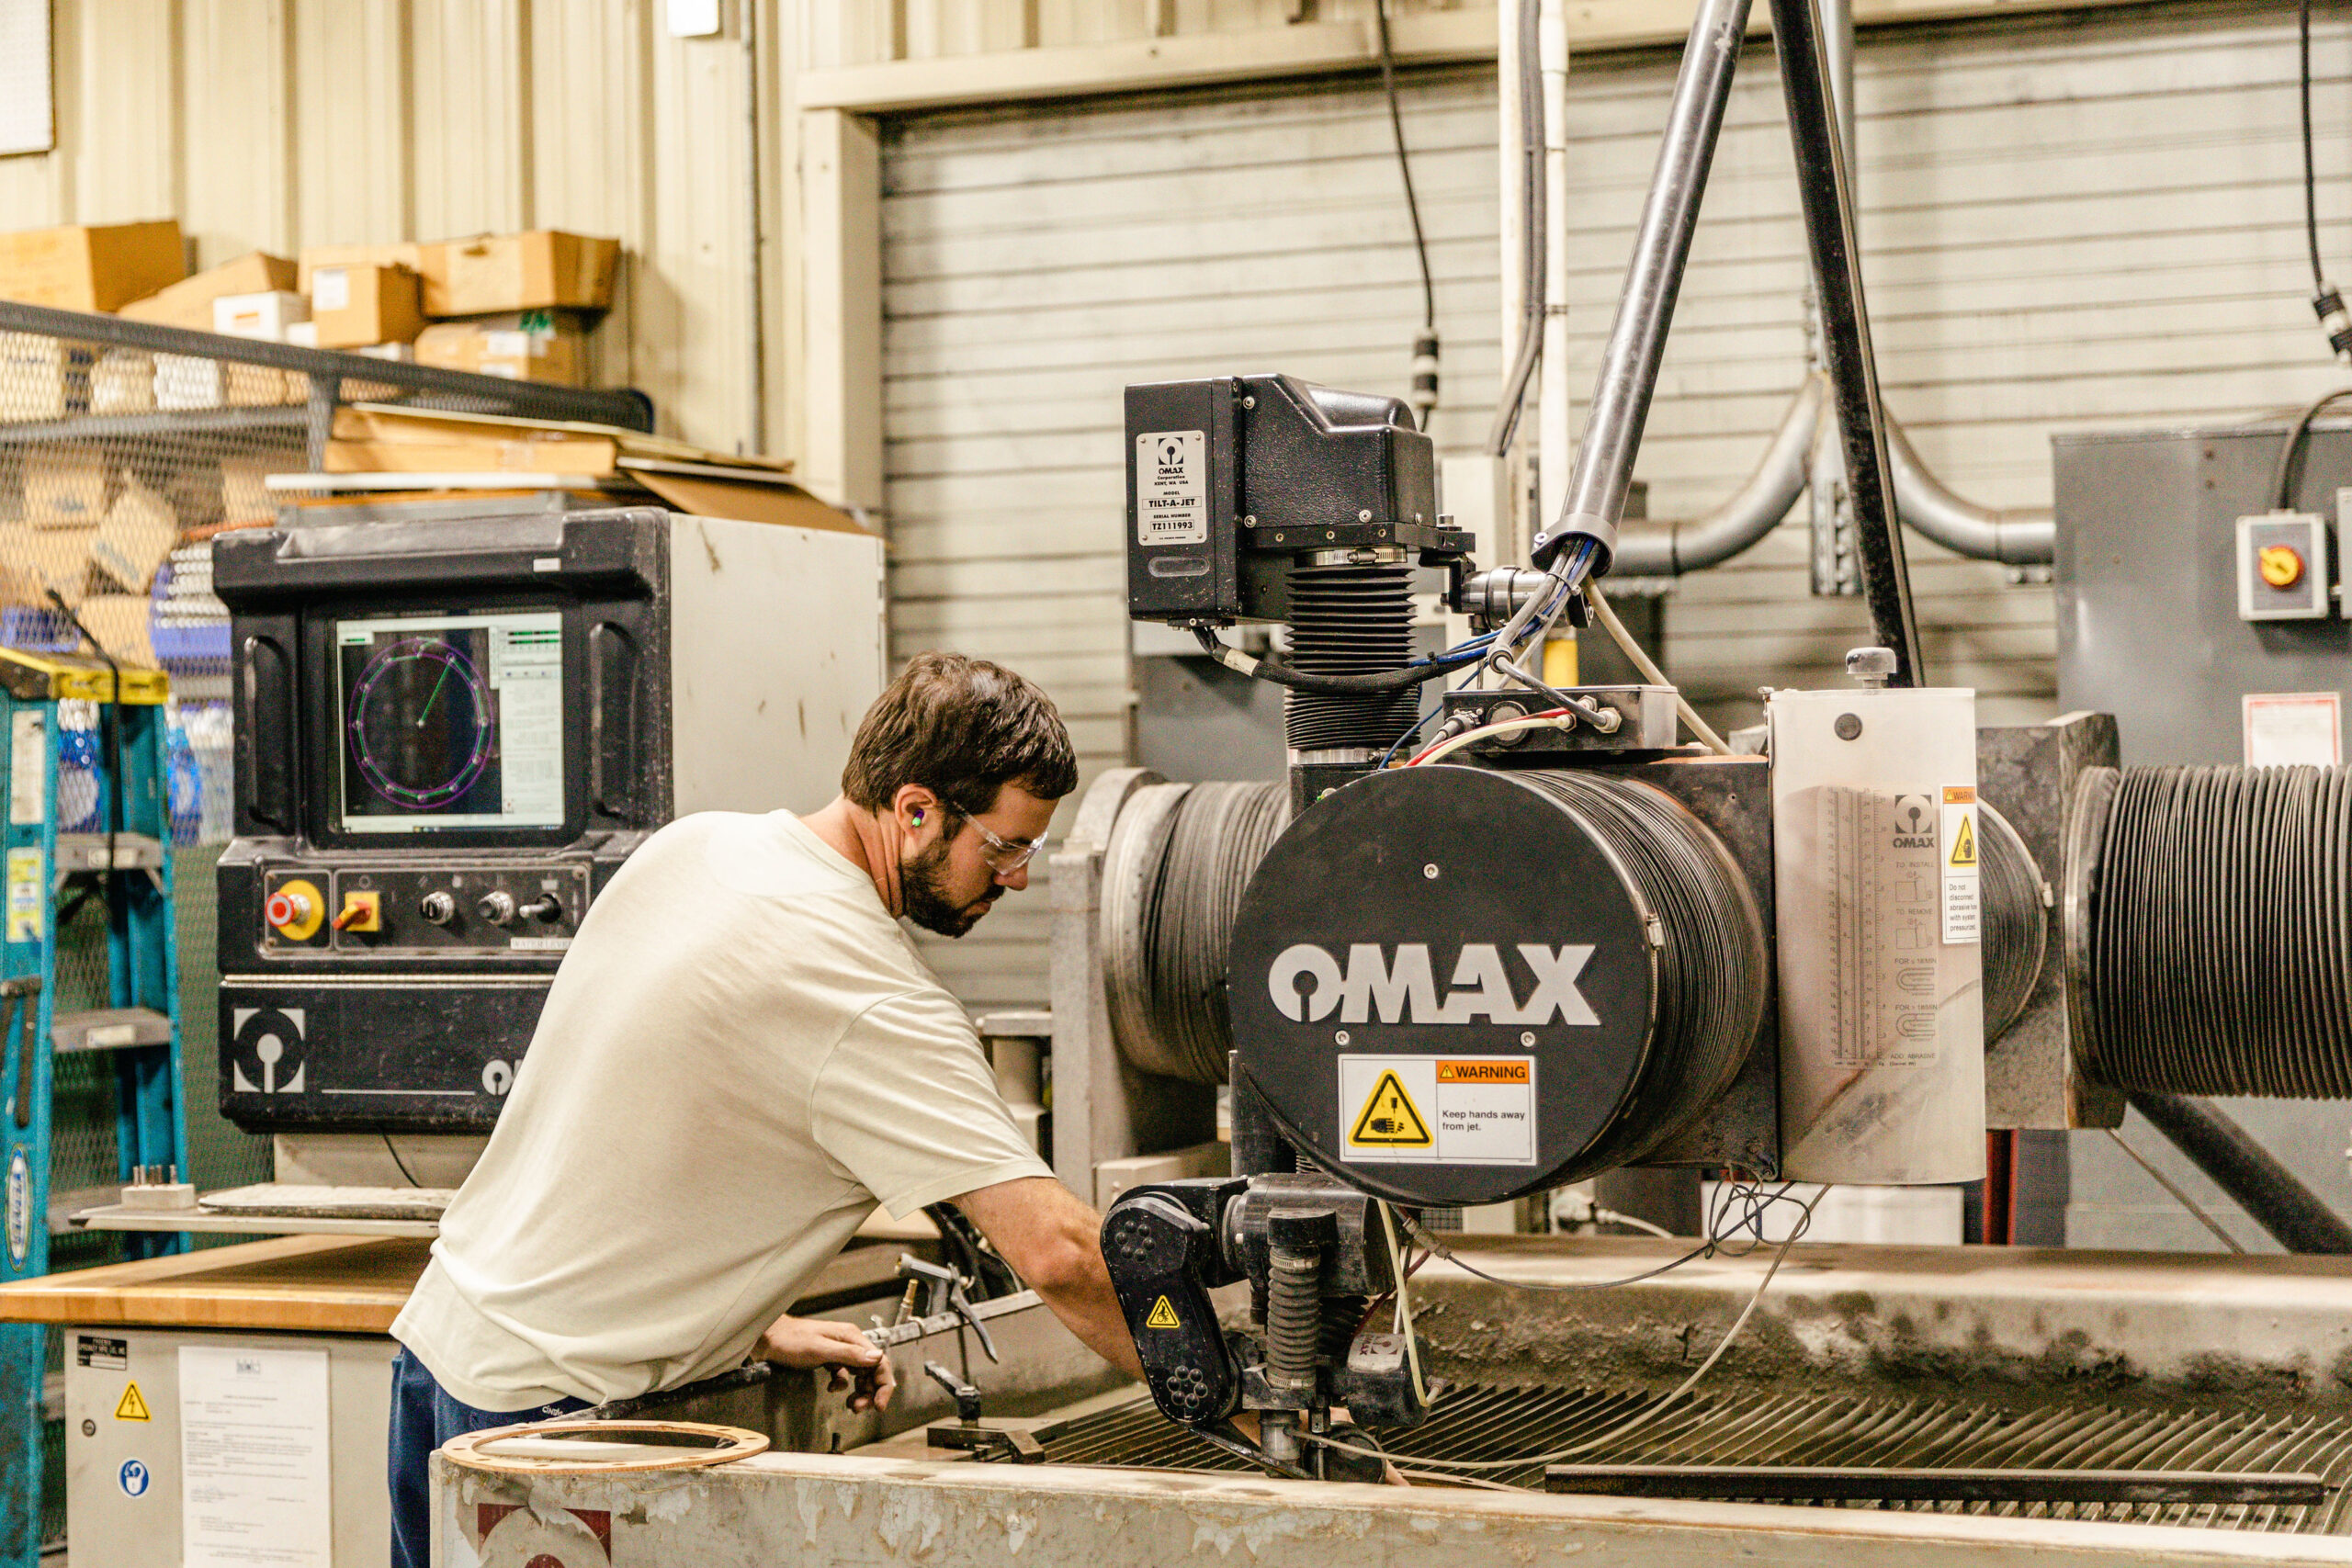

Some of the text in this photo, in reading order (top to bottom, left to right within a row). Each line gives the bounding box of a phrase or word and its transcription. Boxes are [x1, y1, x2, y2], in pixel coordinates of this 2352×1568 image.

[1159, 467, 1184, 475] OMAX
[1148, 498, 1195, 508] TILT-A-JET
[1152, 521, 1193, 530] TZ111993
[1893, 837, 1934, 849] OMAX
[1949, 883, 1957, 891] Do
[1949, 903, 1970, 911] abrasive
[1268, 942, 1601, 1026] OMAX
[1455, 1066, 1526, 1078] WARNING
[1442, 1110, 1525, 1121] Keep hands away
[1442, 1122, 1482, 1133] from jet.
